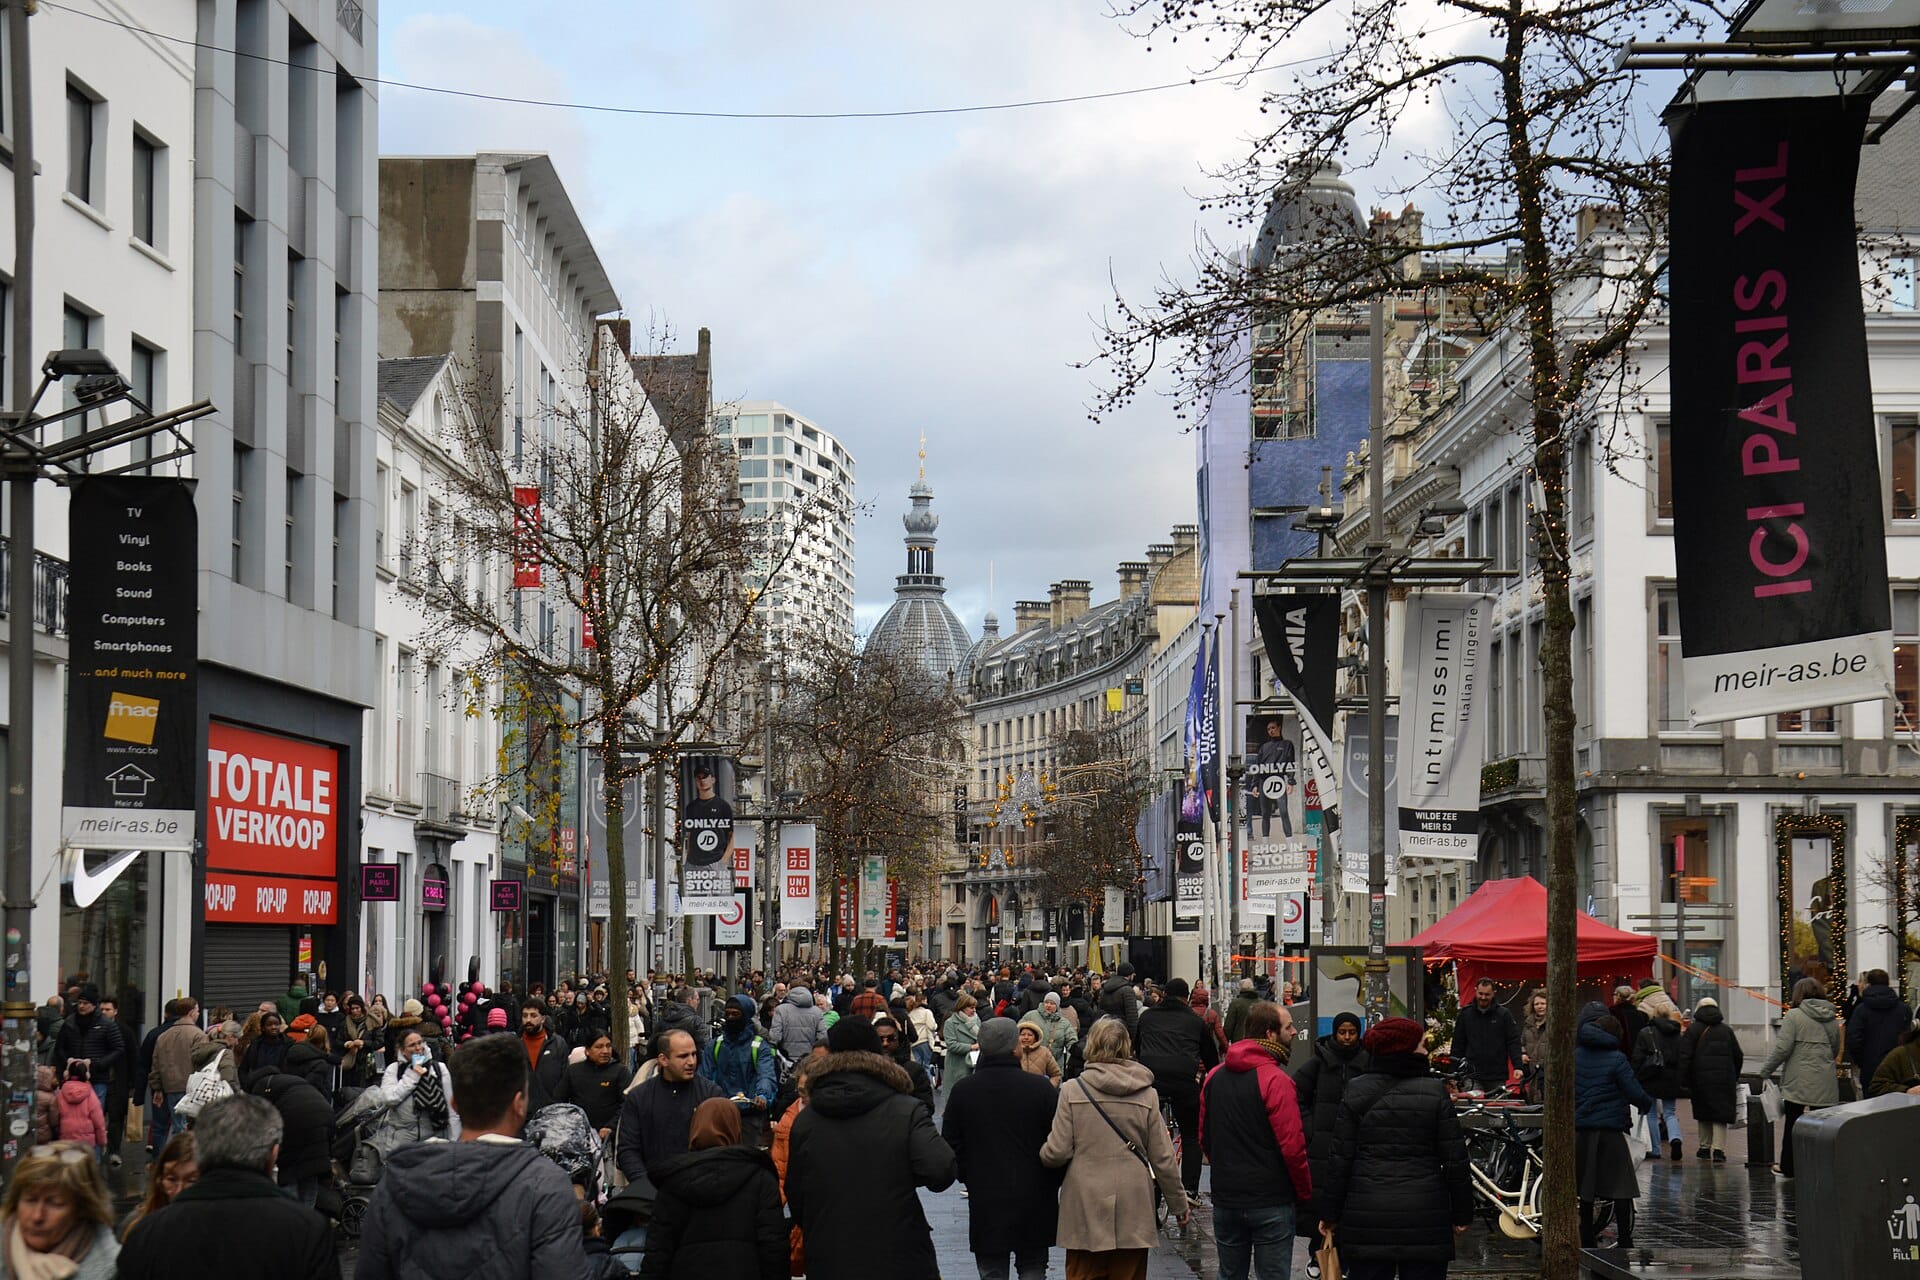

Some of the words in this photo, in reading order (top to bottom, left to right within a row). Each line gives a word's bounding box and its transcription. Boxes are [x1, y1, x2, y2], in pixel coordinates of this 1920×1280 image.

[1734, 141, 1788, 235] XL
[1734, 268, 1801, 477] PARIS
[126, 507, 143, 518] TV
[119, 534, 151, 547] Vinyl
[1746, 502, 1813, 598] ICI
[116, 561, 152, 572] Books
[116, 587, 152, 599] Sound
[102, 614, 165, 626] Computers
[1464, 607, 1479, 668] lingerie
[94, 640, 173, 653] Smartphones
[94, 667, 118, 677] and
[121, 668, 152, 679] much
[156, 670, 187, 680] more
[1713, 653, 1868, 694] meir-as.be
[1460, 674, 1473, 722] Italian
[109, 701, 159, 718] fnac
[106, 746, 158, 755] www.fnac.be
[1250, 763, 1284, 774] ONLY
[208, 748, 330, 815] TOTALE
[1267, 781, 1282, 793] JD
[1415, 812, 1441, 820] WILDE
[1442, 812, 1457, 821] ZEE
[80, 817, 178, 834] meir-as.be
[215, 806, 325, 850] VERKOOP
[684, 819, 718, 829] ONLY
[1421, 822, 1441, 831] MEIR
[700, 835, 714, 846] JD
[1409, 835, 1468, 848] meir-as.be
[1191, 847, 1203, 856] JD
[1251, 844, 1287, 854] SHOP
[1252, 853, 1304, 867] STORE
[686, 871, 717, 879] SHOP
[720, 871, 731, 879] IN
[686, 880, 731, 890] STORE
[789, 877, 806, 886] UNI
[1256, 877, 1301, 886] meir-as.be
[256, 887, 288, 913] POP-UP
[303, 890, 332, 915] POP-UP
